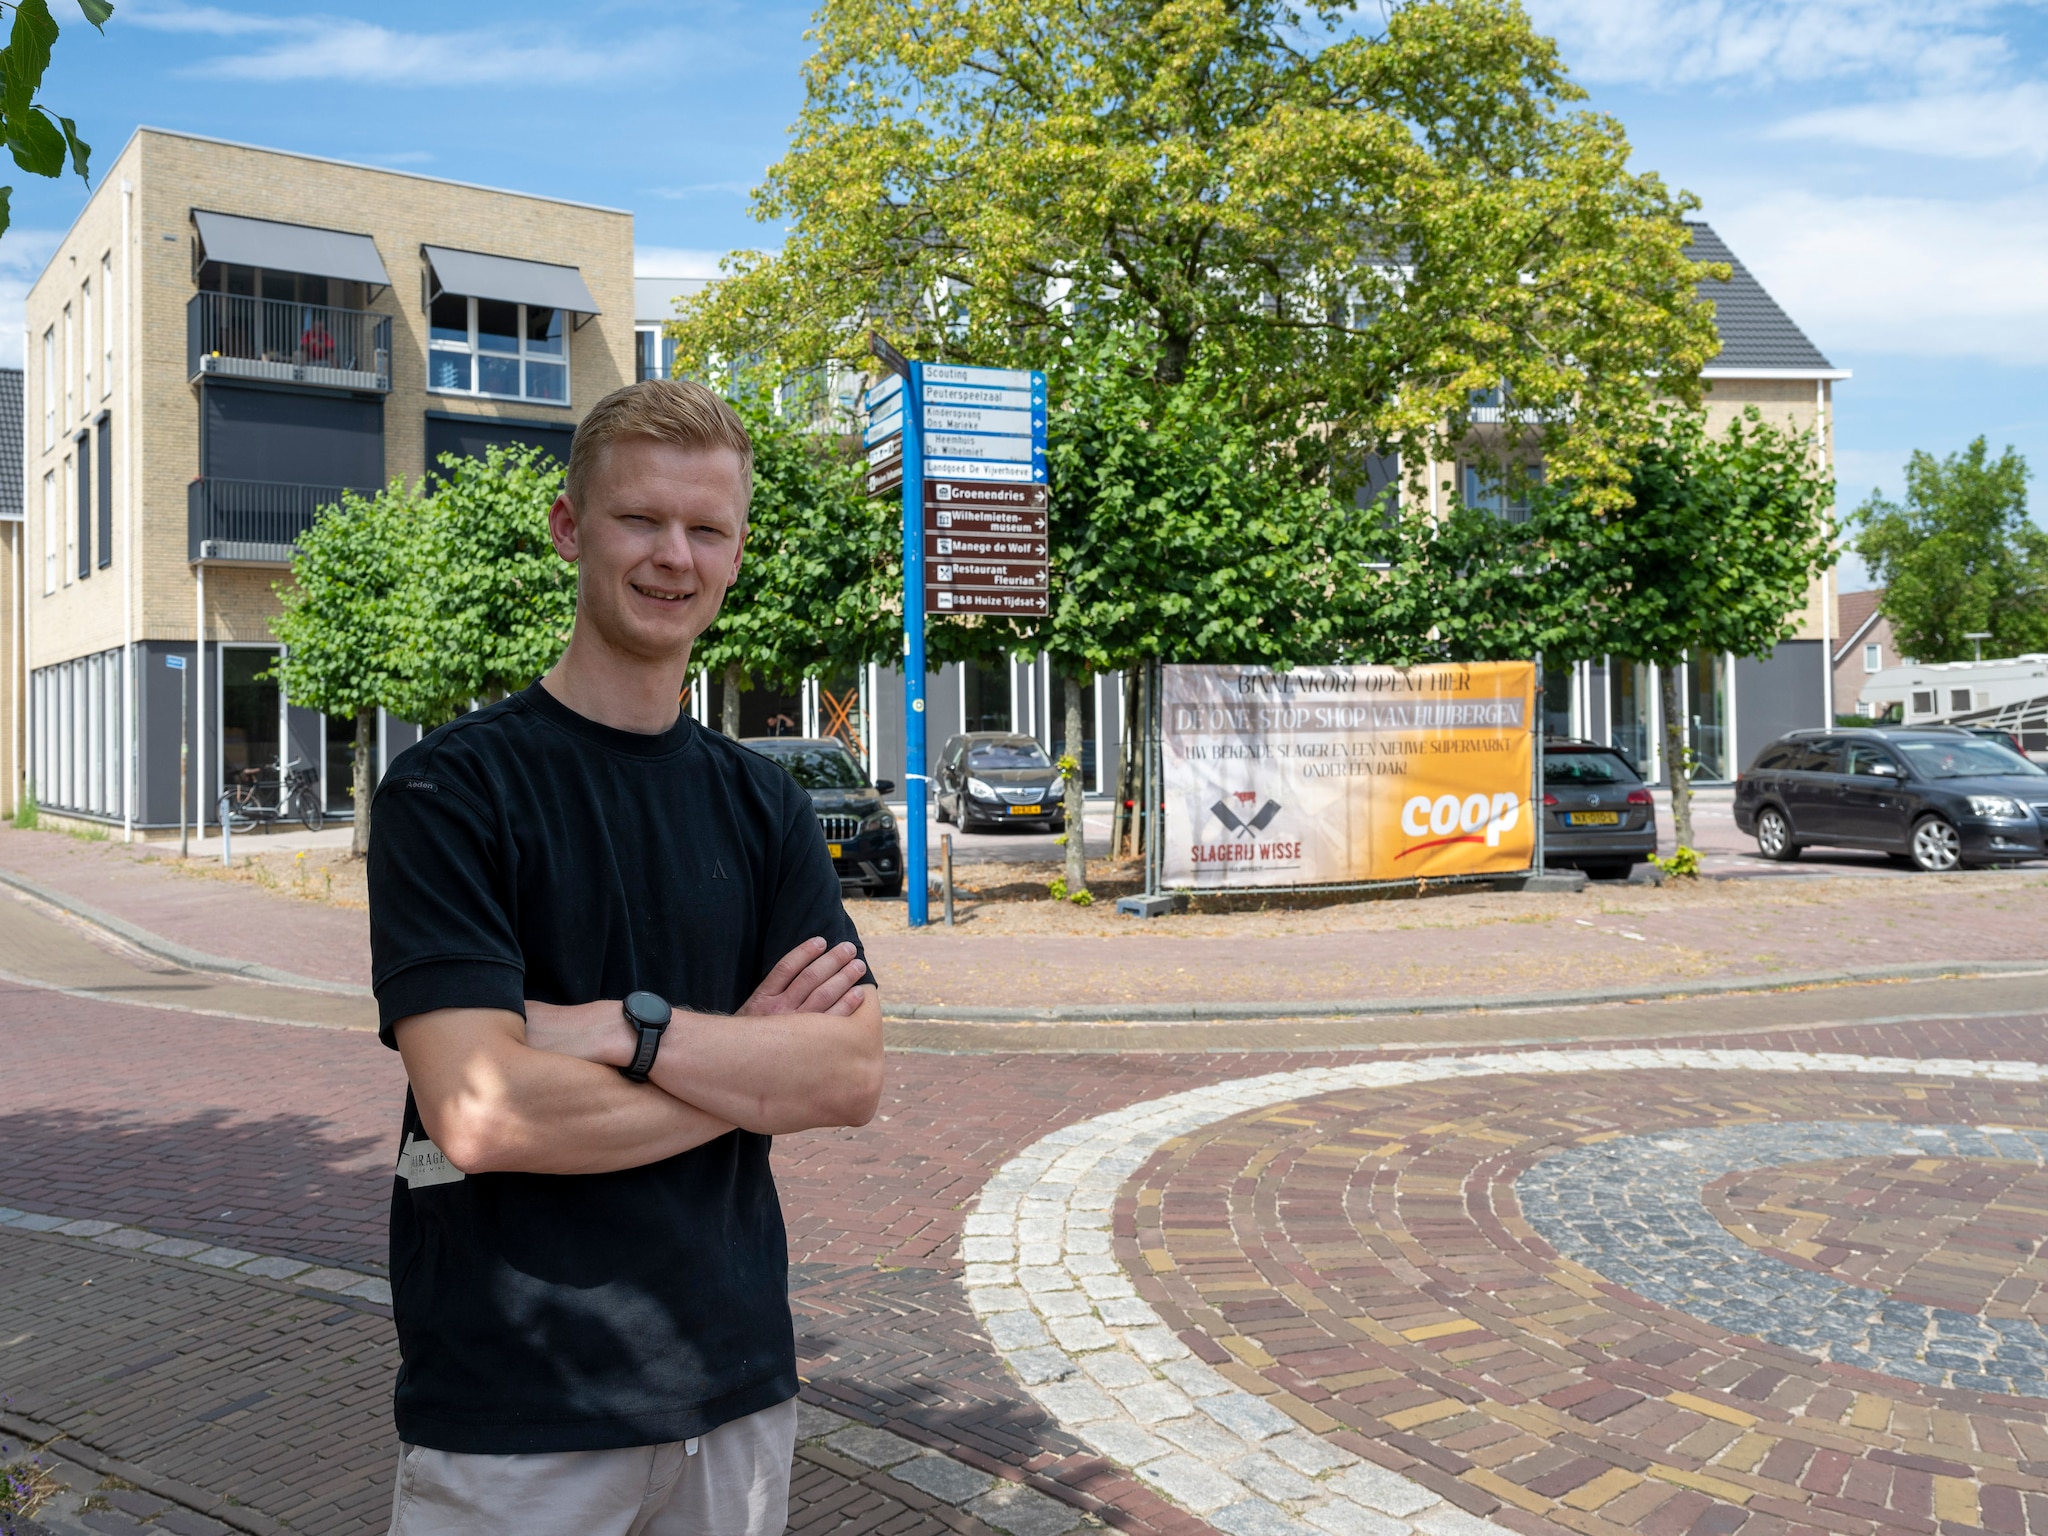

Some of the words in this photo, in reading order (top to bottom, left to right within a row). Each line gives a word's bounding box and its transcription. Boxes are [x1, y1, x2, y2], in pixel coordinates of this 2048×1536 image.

[926, 367, 967, 382] Scouting
[926, 387, 1002, 402] Peuterspeelzaal
[927, 408, 981, 421] Kinderopvang
[927, 419, 942, 428] Ons
[947, 420, 978, 429] Marieke
[935, 435, 975, 445] Heemhuis
[927, 445, 937, 454] De
[942, 446, 983, 456] Wilhelmiet
[927, 462, 965, 474] Landgoed
[969, 465, 979, 473] De
[984, 465, 1028, 477] Vijverhoeve
[951, 488, 1025, 501] Groenendries
[951, 511, 1022, 523] Wilhelmieten-
[990, 523, 1032, 533] museum
[952, 541, 991, 554] Manege
[993, 542, 1006, 553] de
[1008, 543, 1032, 553] Wolf
[952, 563, 1007, 575] Restaurant
[994, 575, 1035, 586] Fleurian
[953, 595, 972, 605] B&B
[974, 596, 1001, 606] Huize
[1238, 674, 1357, 694] BINNENKORT
[1365, 673, 1423, 692] OPENT
[1430, 672, 1471, 691] HIER
[1177, 709, 1204, 731] DE
[1315, 706, 1367, 728] SHOP
[1372, 706, 1409, 728] VAN
[1413, 703, 1522, 726] HUIJBERGEN
[1185, 745, 1208, 760] UW
[1212, 744, 1275, 760] BEKENDE
[1277, 743, 1329, 757] SLAGER
[1332, 742, 1348, 757] EN
[1352, 742, 1376, 757] EEN
[1379, 740, 1428, 756] NIEUWE
[1430, 738, 1511, 754] SUPERMARKT
[1303, 763, 1346, 778] ONDER
[1377, 761, 1408, 775] DAK!
[1401, 792, 1519, 847] coop
[1191, 843, 1255, 863] SLAGERIJ
[1260, 842, 1302, 860] WISSE
